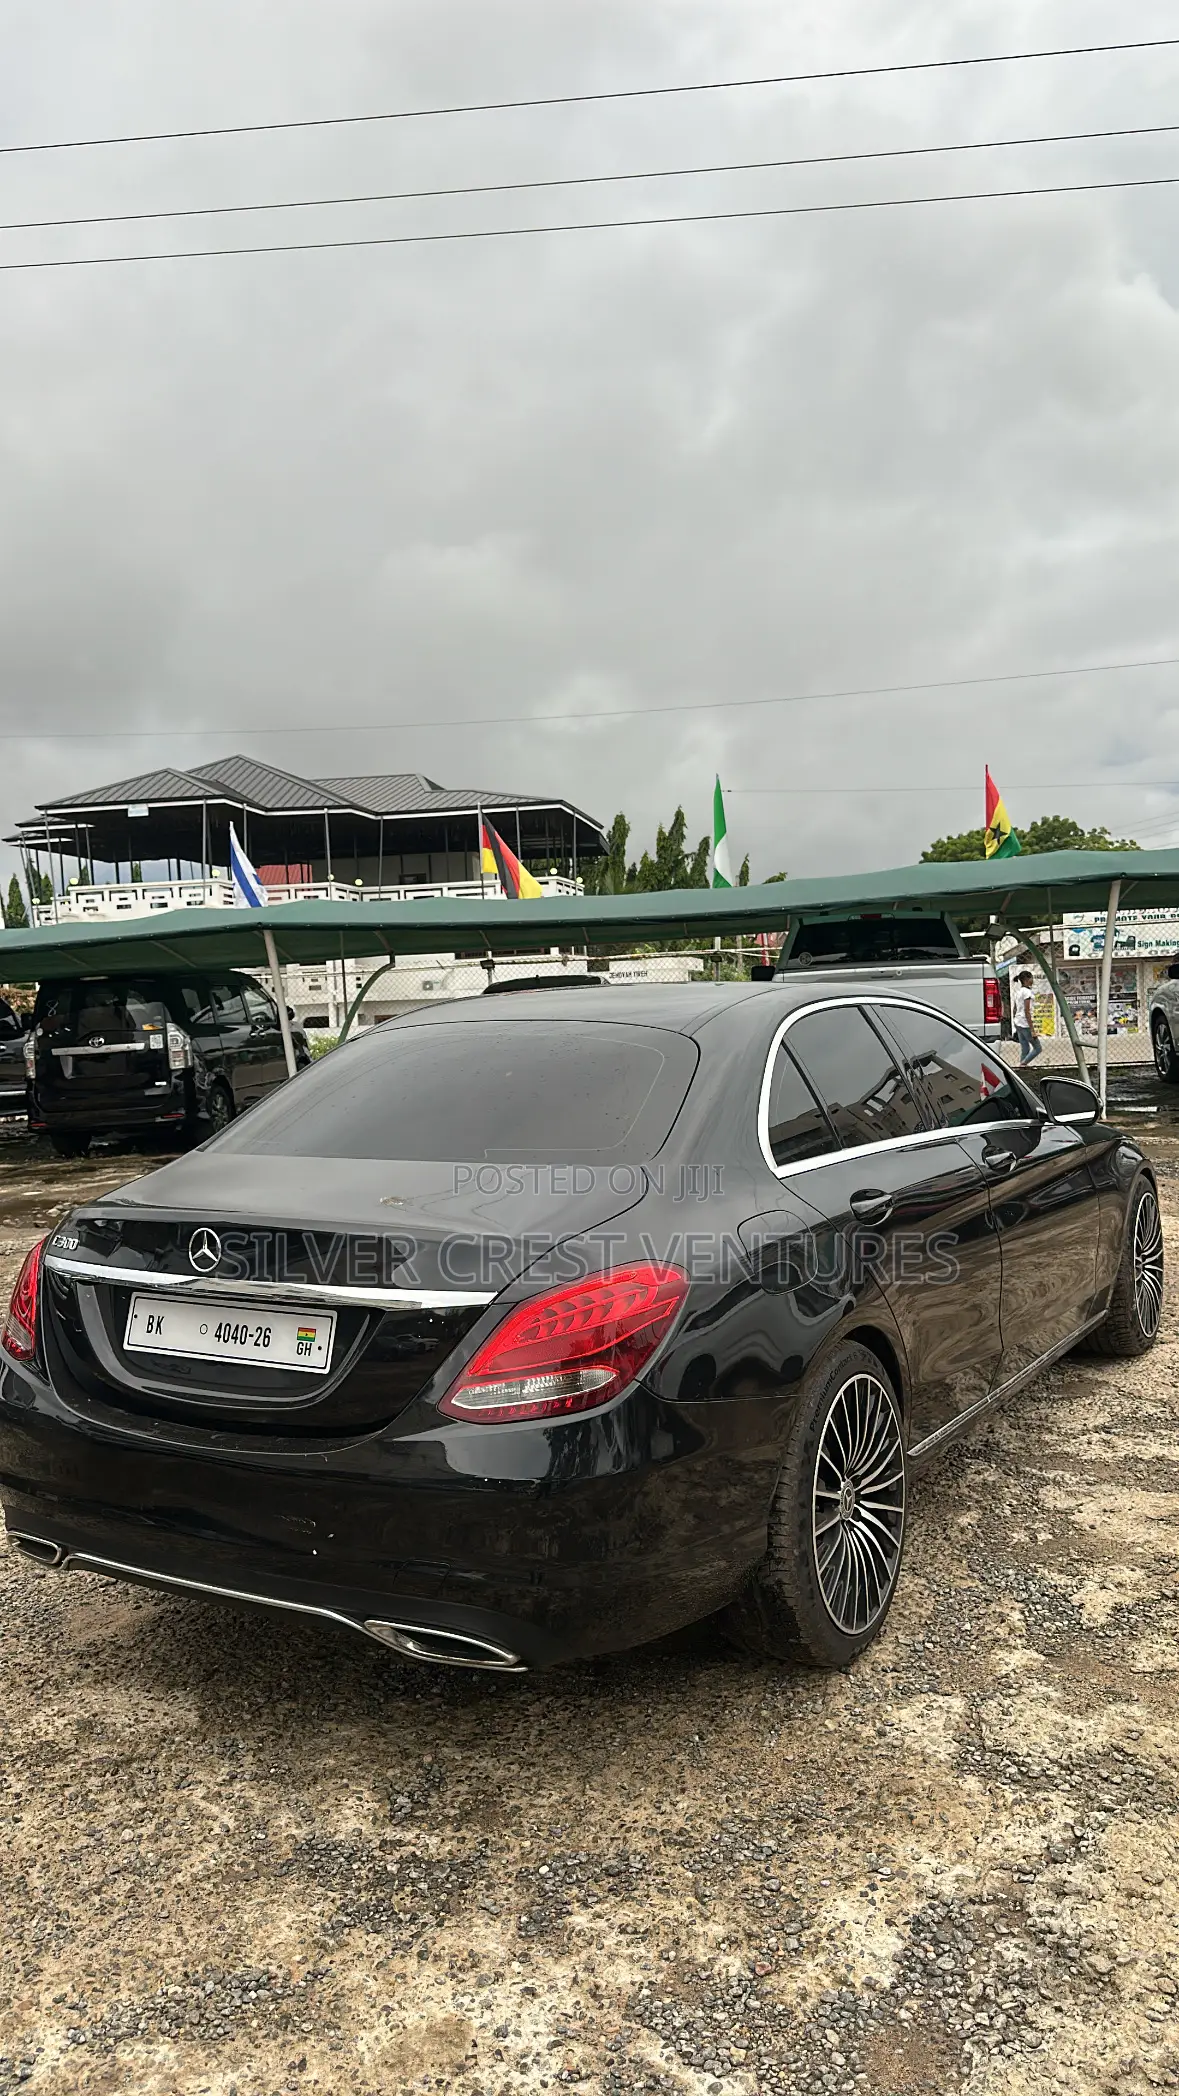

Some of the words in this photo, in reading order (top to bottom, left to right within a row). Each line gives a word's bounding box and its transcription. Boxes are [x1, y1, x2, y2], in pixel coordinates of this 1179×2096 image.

[1137, 940, 1153, 949] Sign
[52, 1234, 79, 1250] C300
[146, 1314, 165, 1335] BK
[214, 1322, 272, 1348] 4040-26
[296, 1341, 313, 1357] GH
